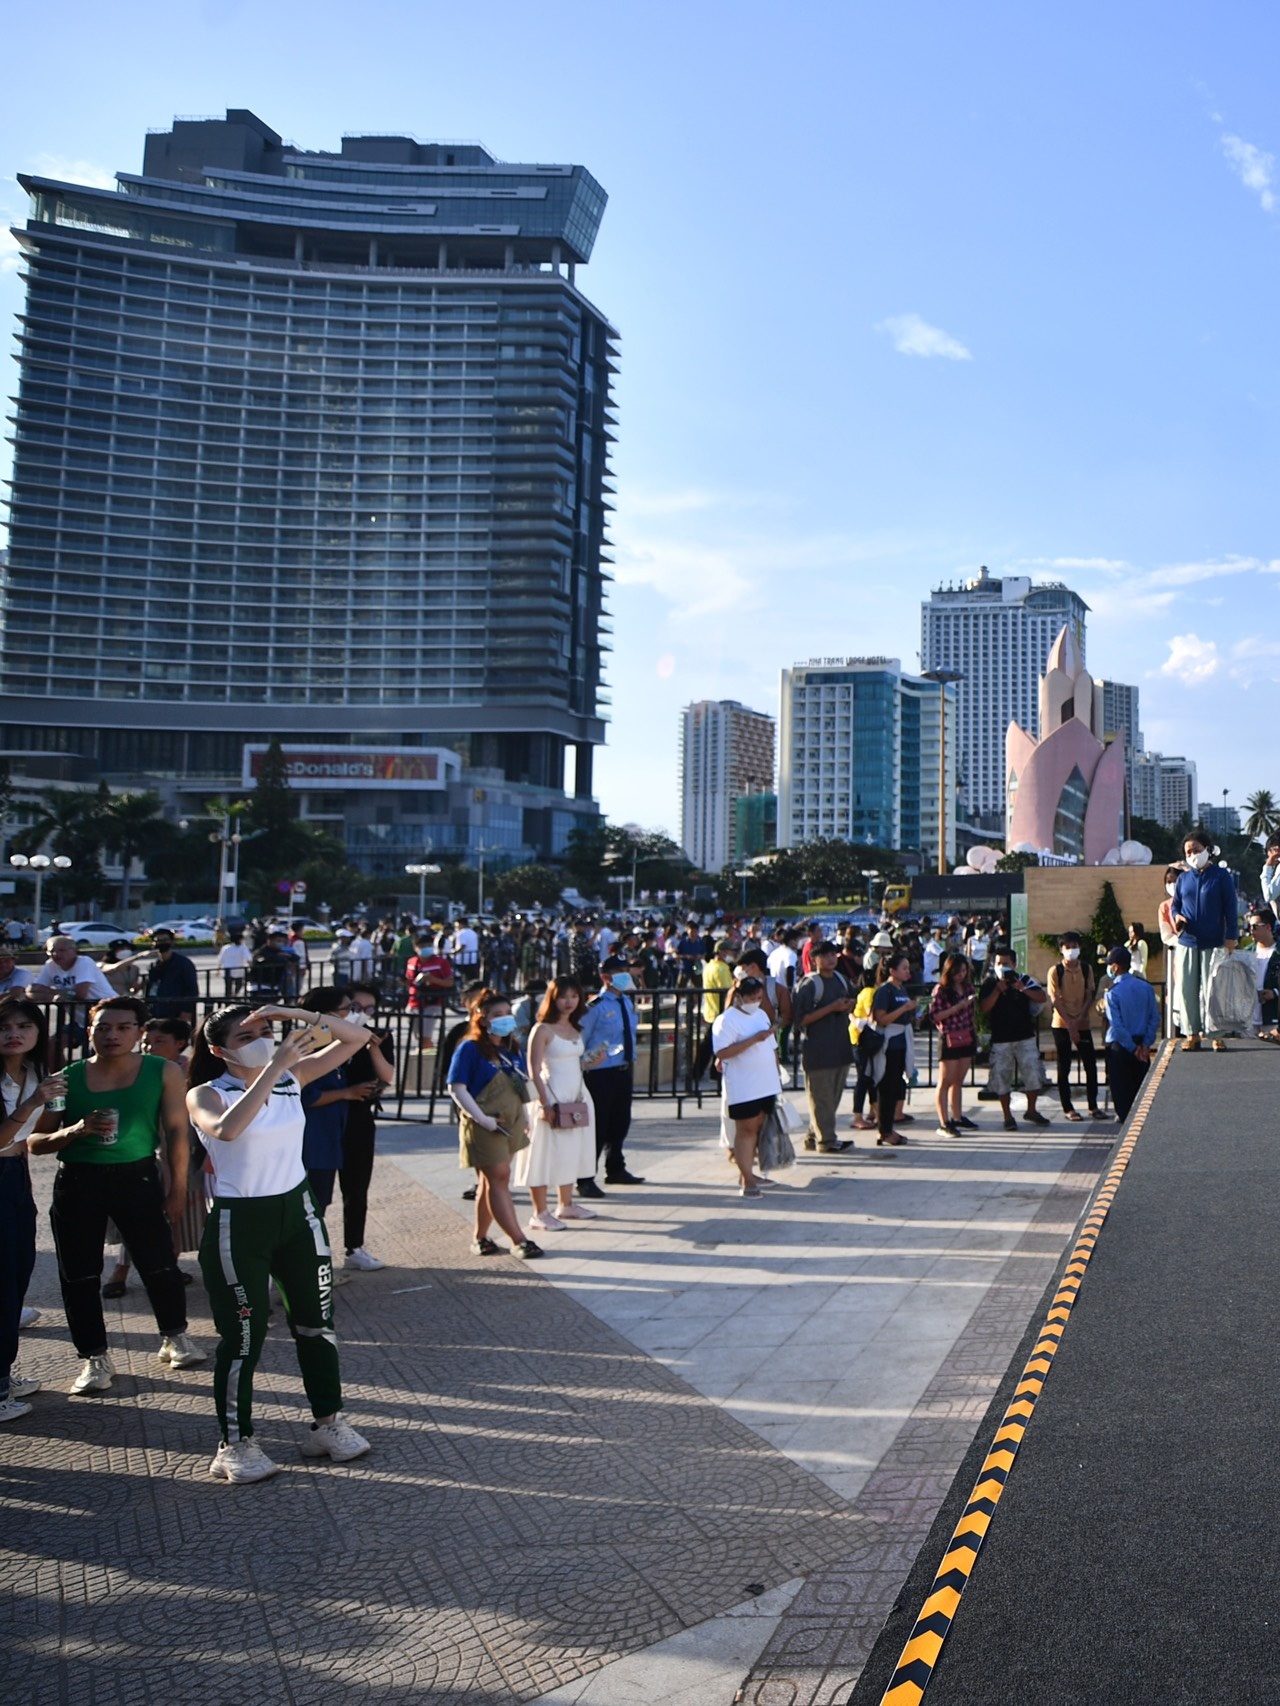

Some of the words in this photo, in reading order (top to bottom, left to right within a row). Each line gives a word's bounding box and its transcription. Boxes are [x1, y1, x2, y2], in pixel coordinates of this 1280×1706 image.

[824, 657, 844, 665] TRANG
[846, 656, 865, 666] LODGE
[866, 655, 887, 665] HOTEL
[234, 1285, 249, 1306] SILVER
[318, 1262, 332, 1321] SILVER
[239, 1318, 251, 1356] Heineken
